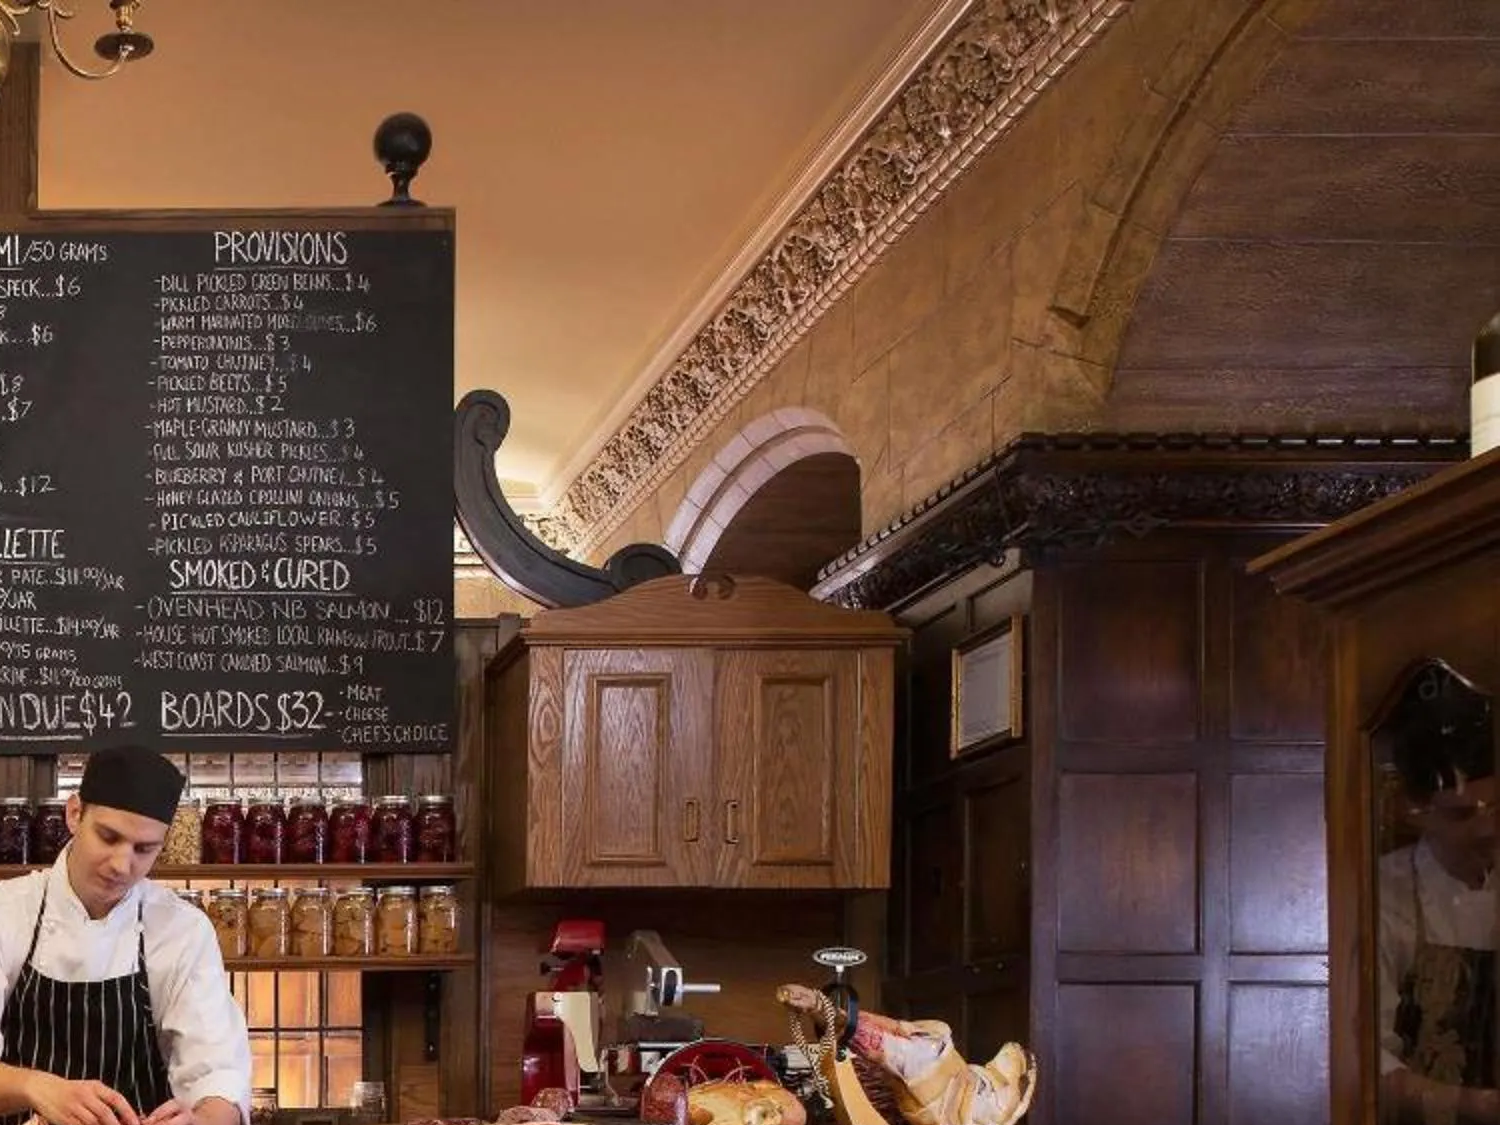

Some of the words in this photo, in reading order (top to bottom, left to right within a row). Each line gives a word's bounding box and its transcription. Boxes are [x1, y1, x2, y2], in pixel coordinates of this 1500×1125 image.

[59, 241, 108, 263] GRAMS
[213, 231, 348, 265] PROVISIONS
[160, 274, 190, 293] DILL
[160, 355, 209, 371] TOMATO
[157, 397, 182, 413] HOT
[161, 512, 225, 531] PICKLED
[155, 537, 213, 555] PICKLED
[169, 559, 257, 590] SMOKED
[274, 558, 351, 591] CURED
[271, 598, 306, 620] NB
[347, 685, 382, 702] MEAT
[79, 689, 137, 737] $42
[161, 690, 271, 731] BOARDS
[277, 690, 326, 733] $32
